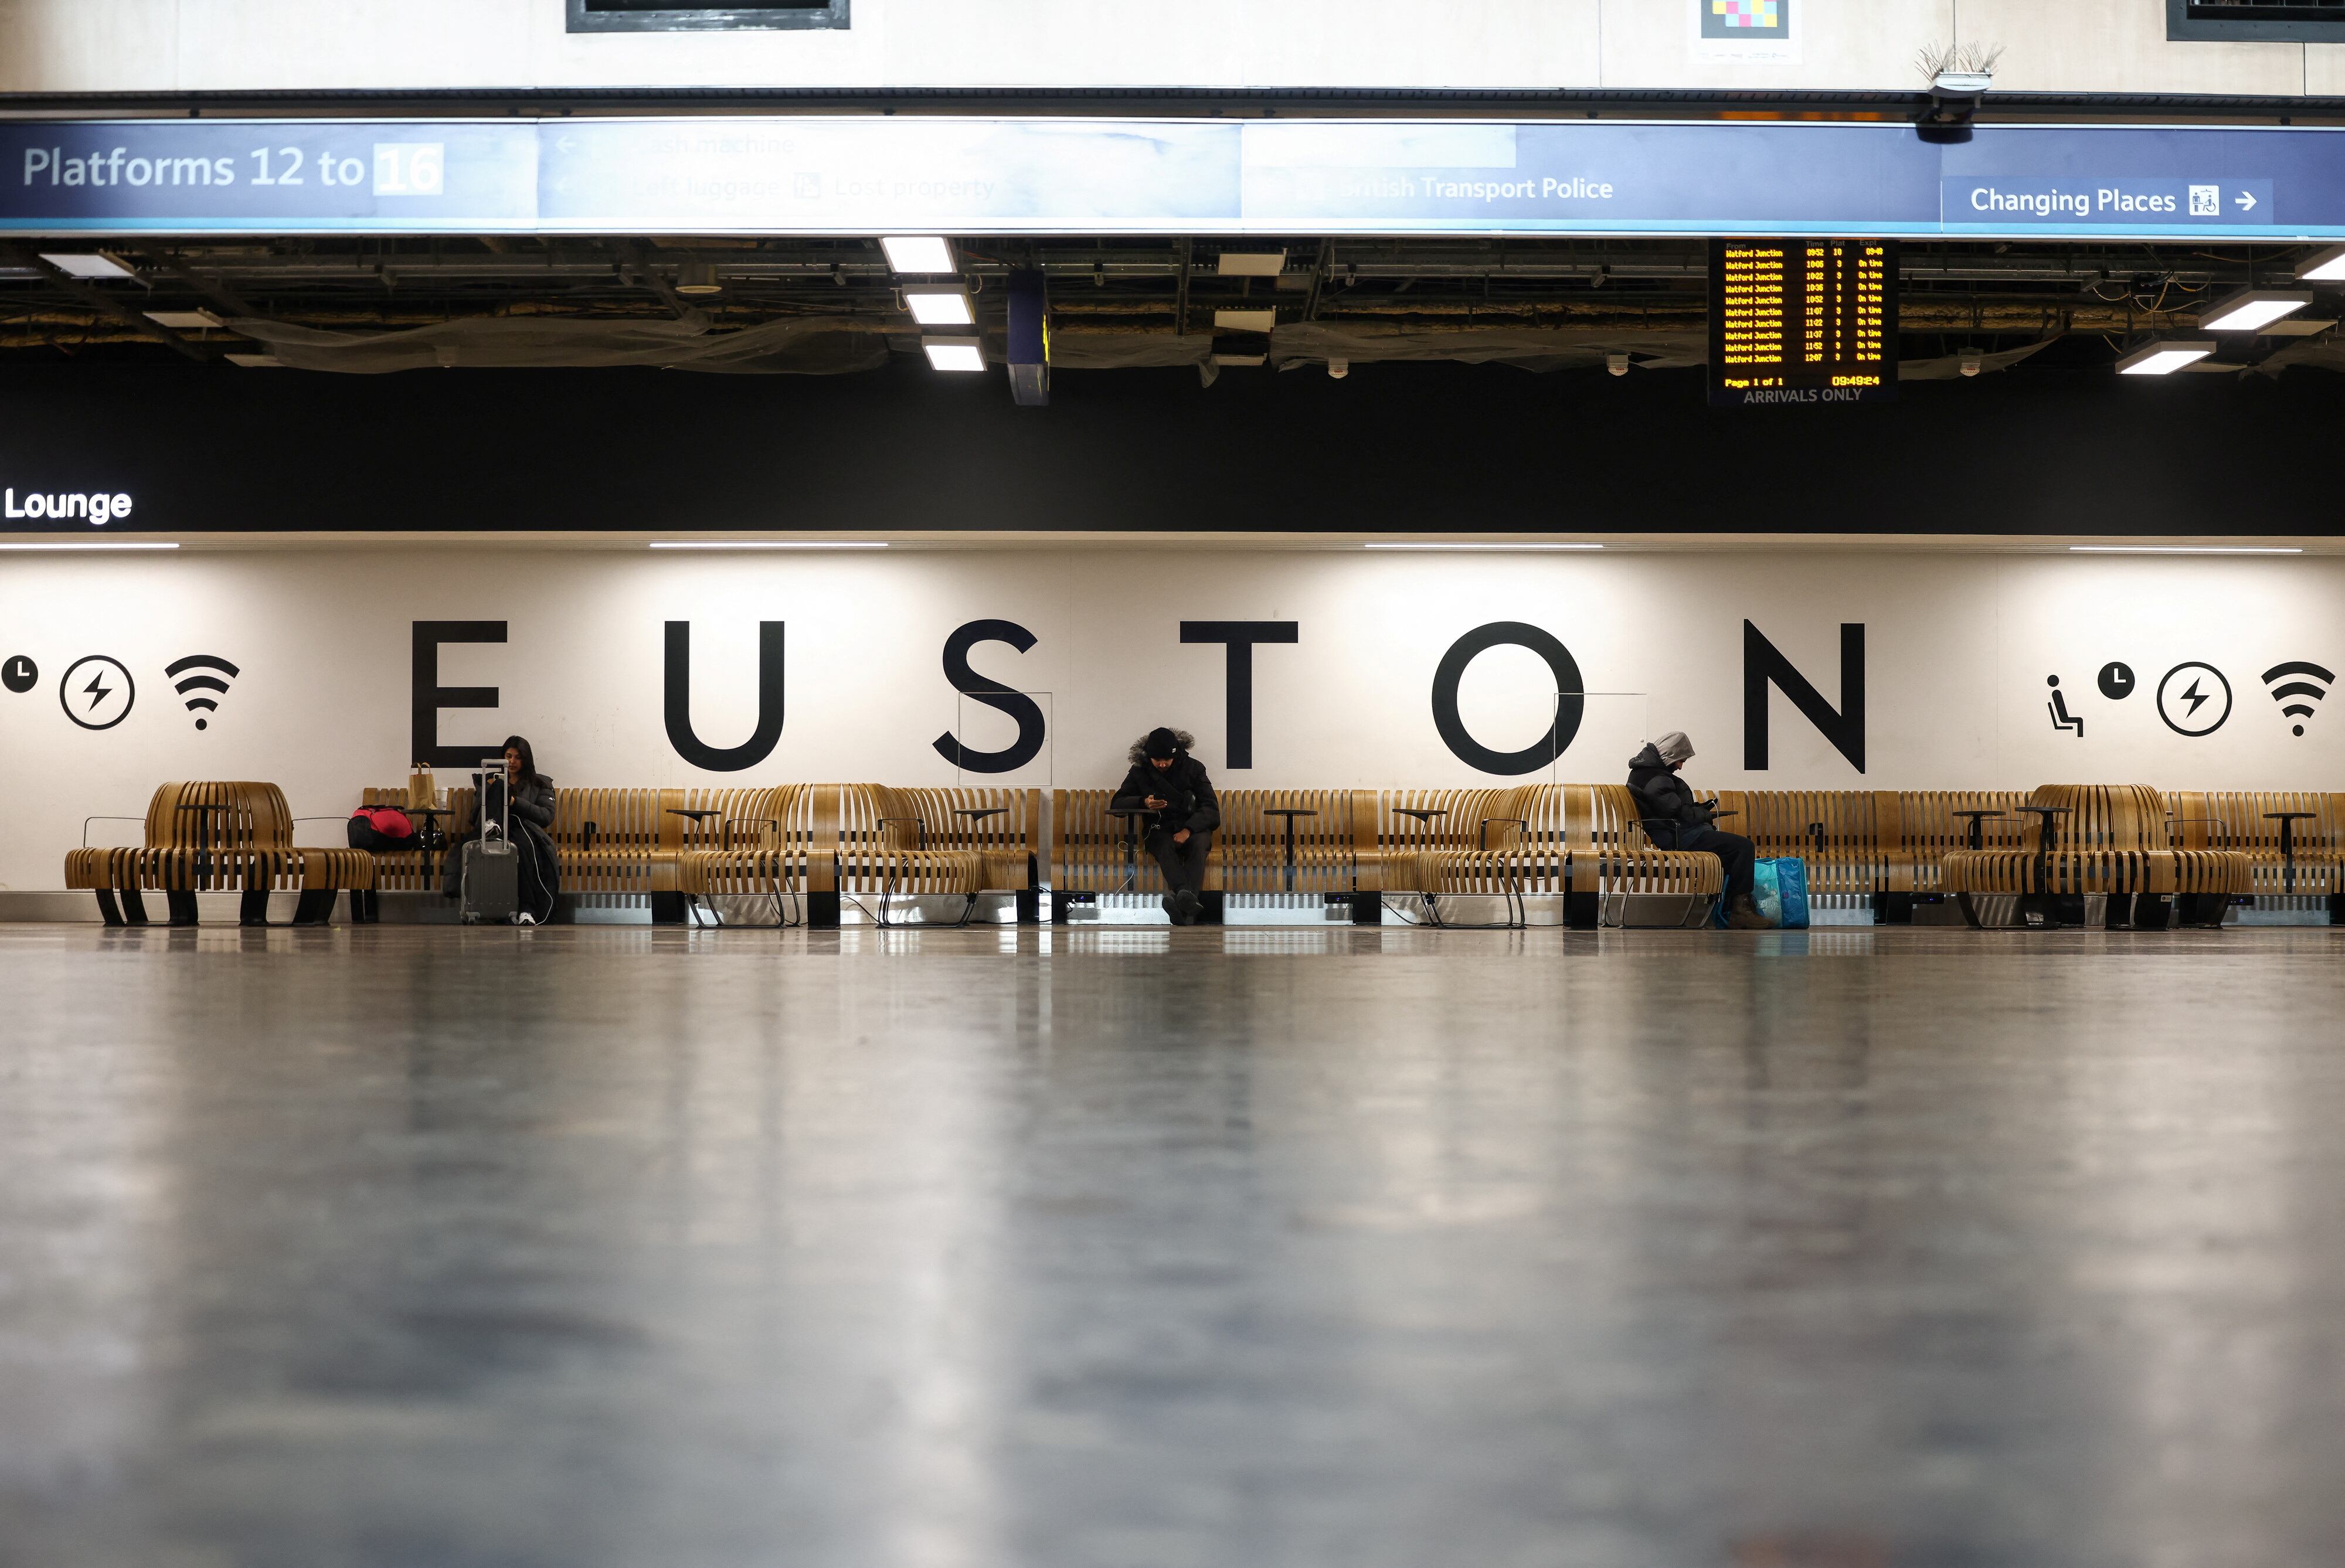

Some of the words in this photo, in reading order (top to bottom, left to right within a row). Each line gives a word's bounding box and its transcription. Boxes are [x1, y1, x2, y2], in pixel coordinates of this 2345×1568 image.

[638, 132, 689, 154] ash
[696, 133, 795, 154] machine
[24, 147, 235, 186] Platforms
[250, 147, 304, 185] 12
[317, 151, 365, 186] to
[378, 148, 440, 192] 16
[686, 175, 780, 202] luggage
[835, 176, 886, 197] Lost
[893, 178, 995, 200] property
[1420, 177, 1536, 202] Transport
[1542, 177, 1613, 199] Police
[1971, 188, 2089, 216] Changing
[2098, 189, 2176, 212] Places
[1860, 239, 1877, 247] Expt
[1754, 355, 1782, 363] Junction
[1806, 353, 1822, 362] 12:07
[1725, 379, 1749, 388] Page
[1753, 378, 1759, 386] 1
[1832, 376, 1880, 386] 09:49:24
[1744, 389, 1817, 403] ARRIVALS
[1822, 388, 1863, 402] ONLY
[5, 488, 132, 525] Lounge
[412, 619, 1865, 776] EUSTON
